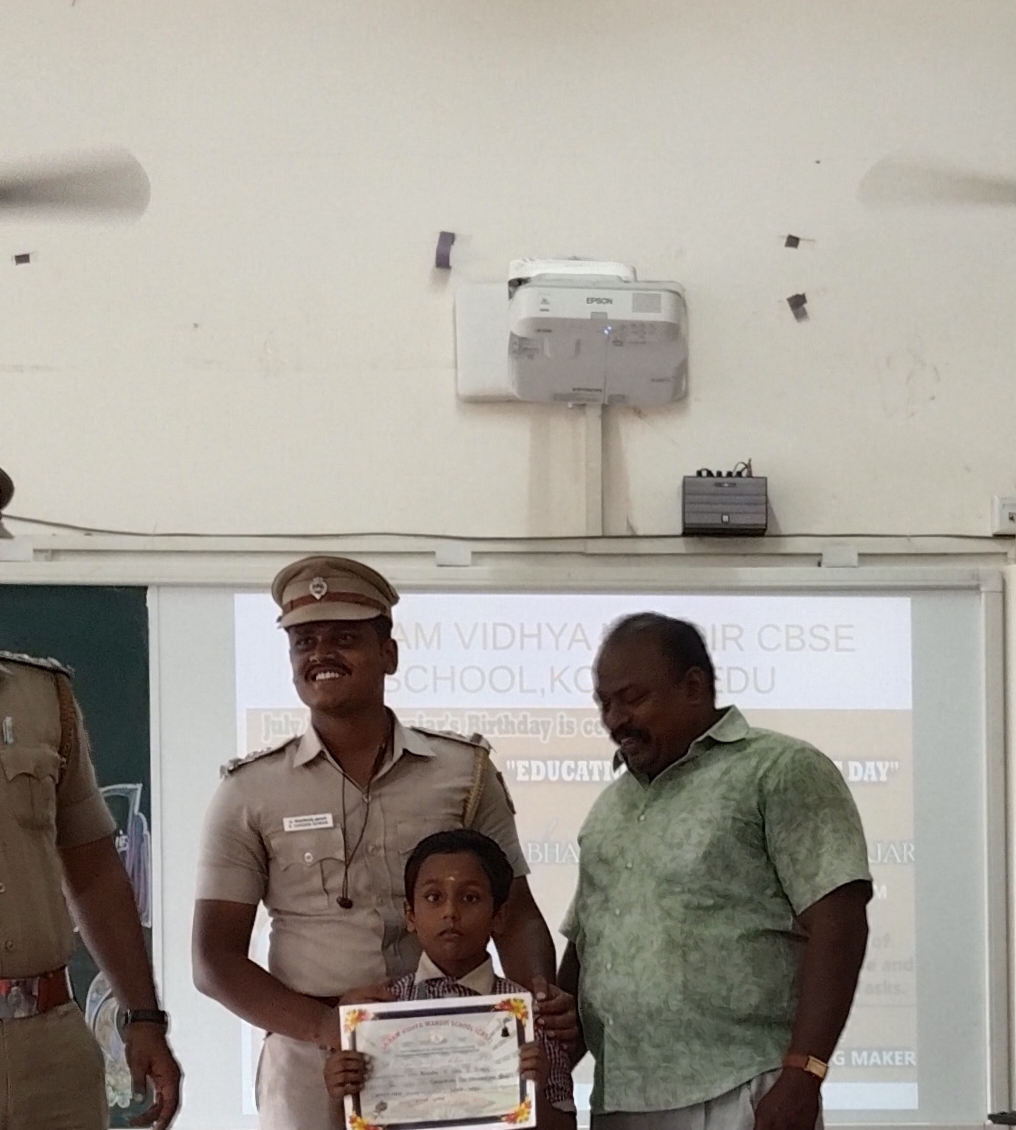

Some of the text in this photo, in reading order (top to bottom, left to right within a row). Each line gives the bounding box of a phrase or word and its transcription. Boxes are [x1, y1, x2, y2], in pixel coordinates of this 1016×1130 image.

[586, 297, 613, 305] EPSON
[453, 622, 591, 651] VIDHYA
[757, 623, 856, 653] CBSE
[465, 712, 552, 742] Birthday
[556, 712, 579, 738] is
[851, 1051, 917, 1067] MAKER
